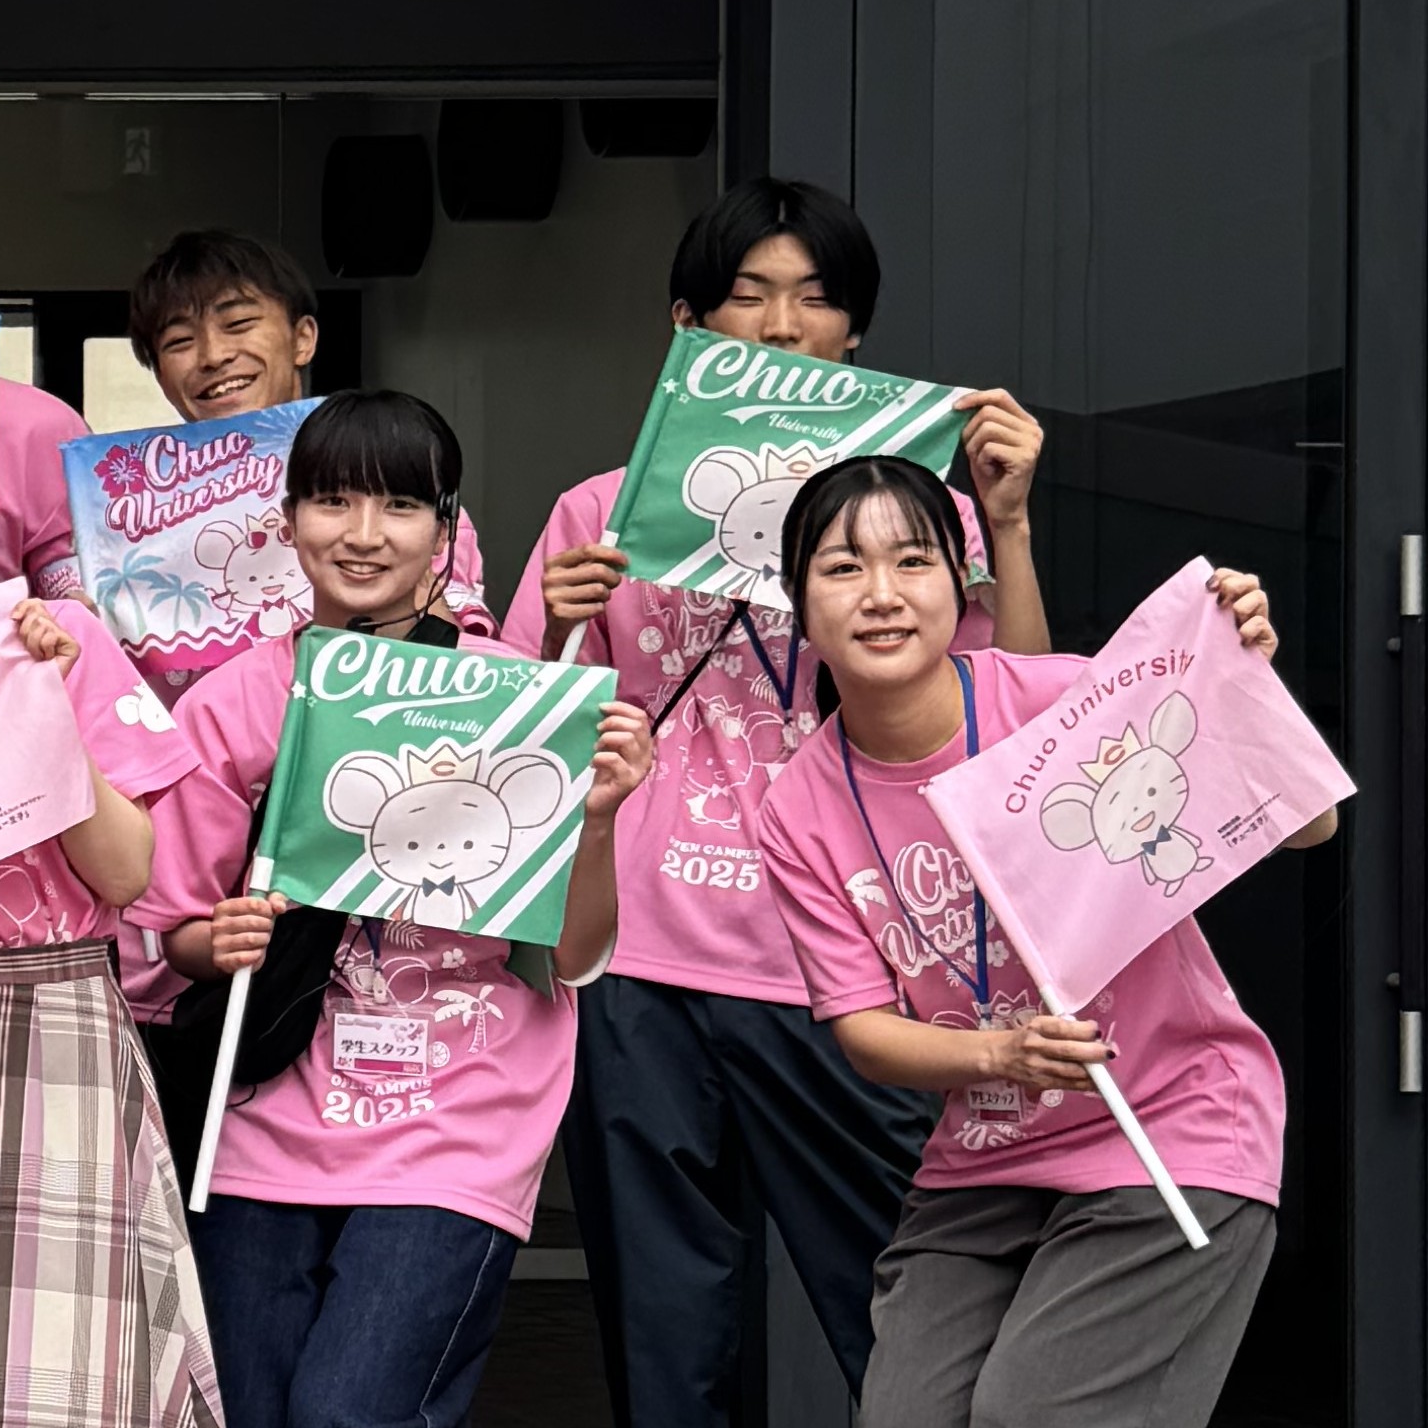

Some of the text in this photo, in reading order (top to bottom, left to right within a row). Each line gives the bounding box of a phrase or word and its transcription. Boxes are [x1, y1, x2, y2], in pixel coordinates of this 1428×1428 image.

[687, 339, 867, 408] Chuo
[141, 432, 255, 494] Chuo
[105, 452, 284, 544] University
[310, 633, 499, 702] Chuo
[402, 709, 484, 739] University
[1005, 737, 1057, 814] Chuo
[659, 848, 761, 892] 2025
[340, 1039, 419, 1056] 学生スタッフ
[321, 1090, 436, 1129] 2025
